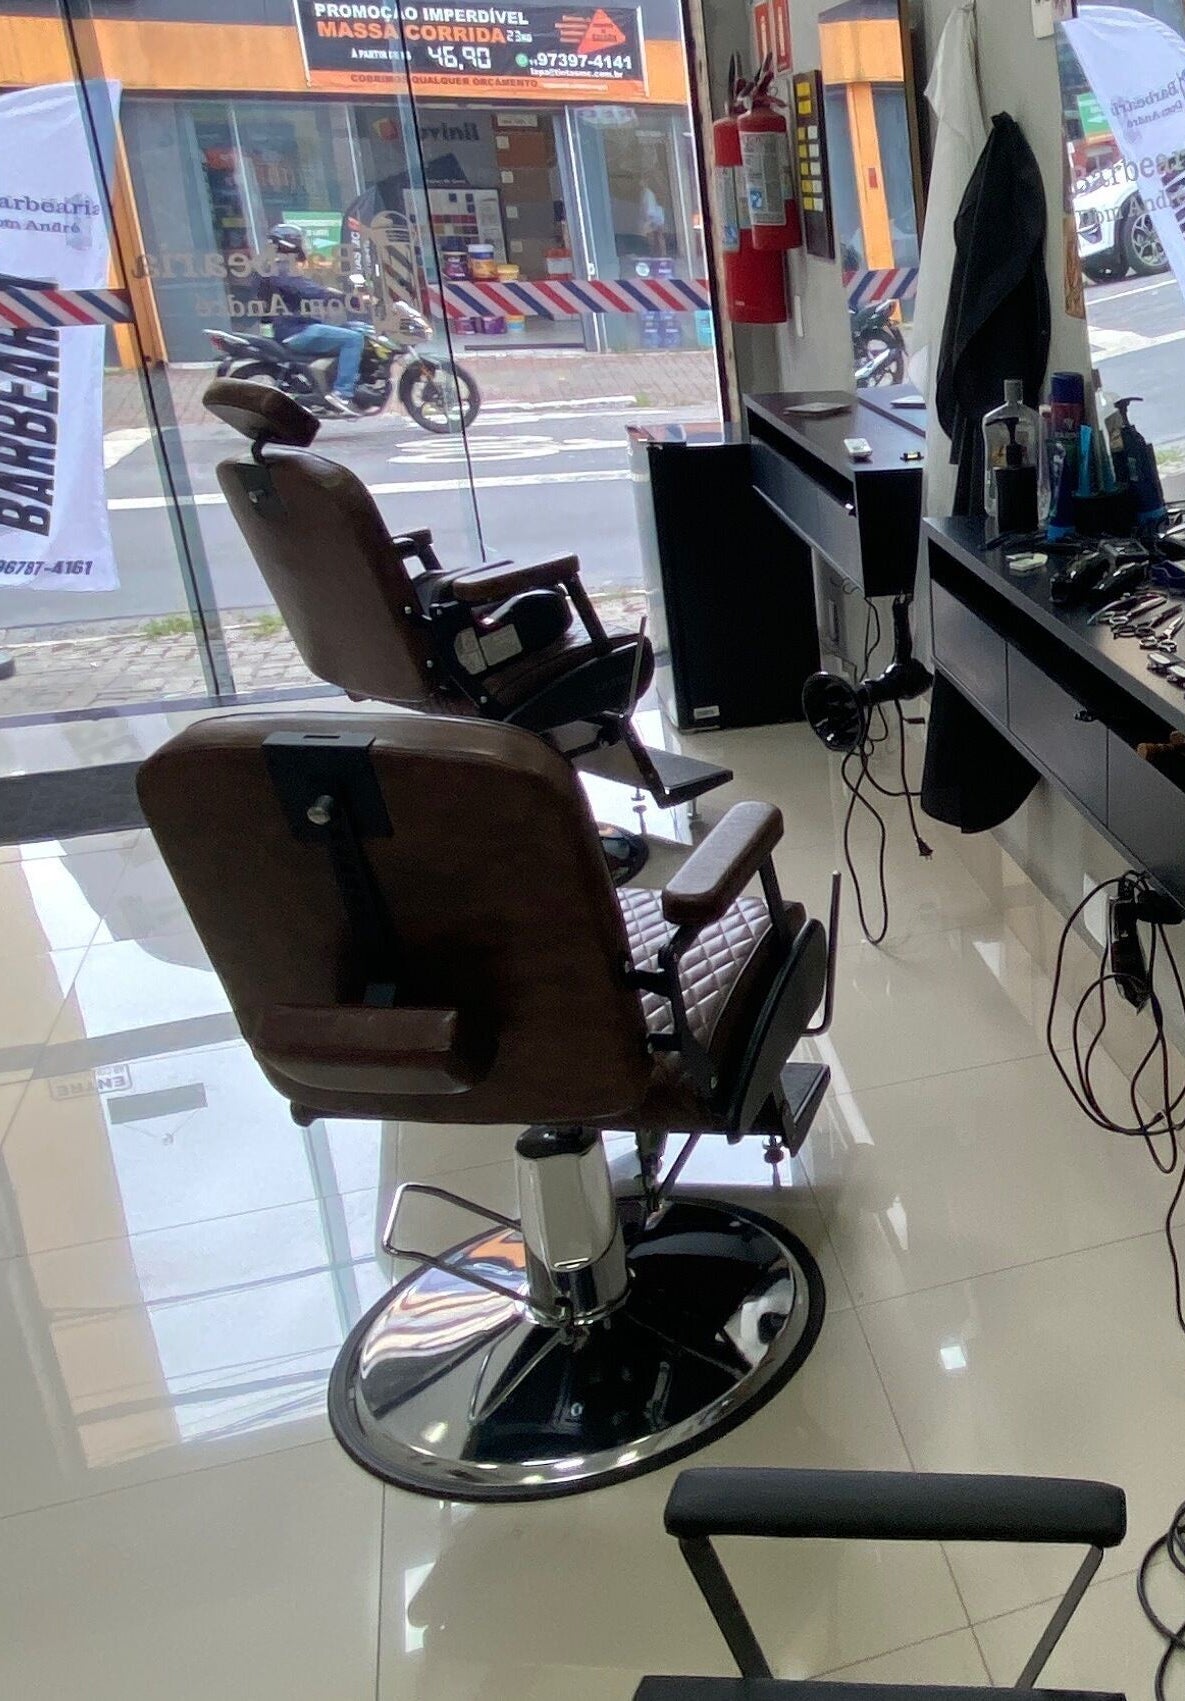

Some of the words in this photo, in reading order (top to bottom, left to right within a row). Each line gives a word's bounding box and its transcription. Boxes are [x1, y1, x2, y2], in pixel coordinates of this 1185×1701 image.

[423, 7, 529, 26] IMPERDÍVEL
[317, 21, 398, 40] MASSA
[405, 24, 506, 44] CORRIDA
[537, 52, 632, 69] 97397-4141
[412, 74, 470, 86] QUALQUER
